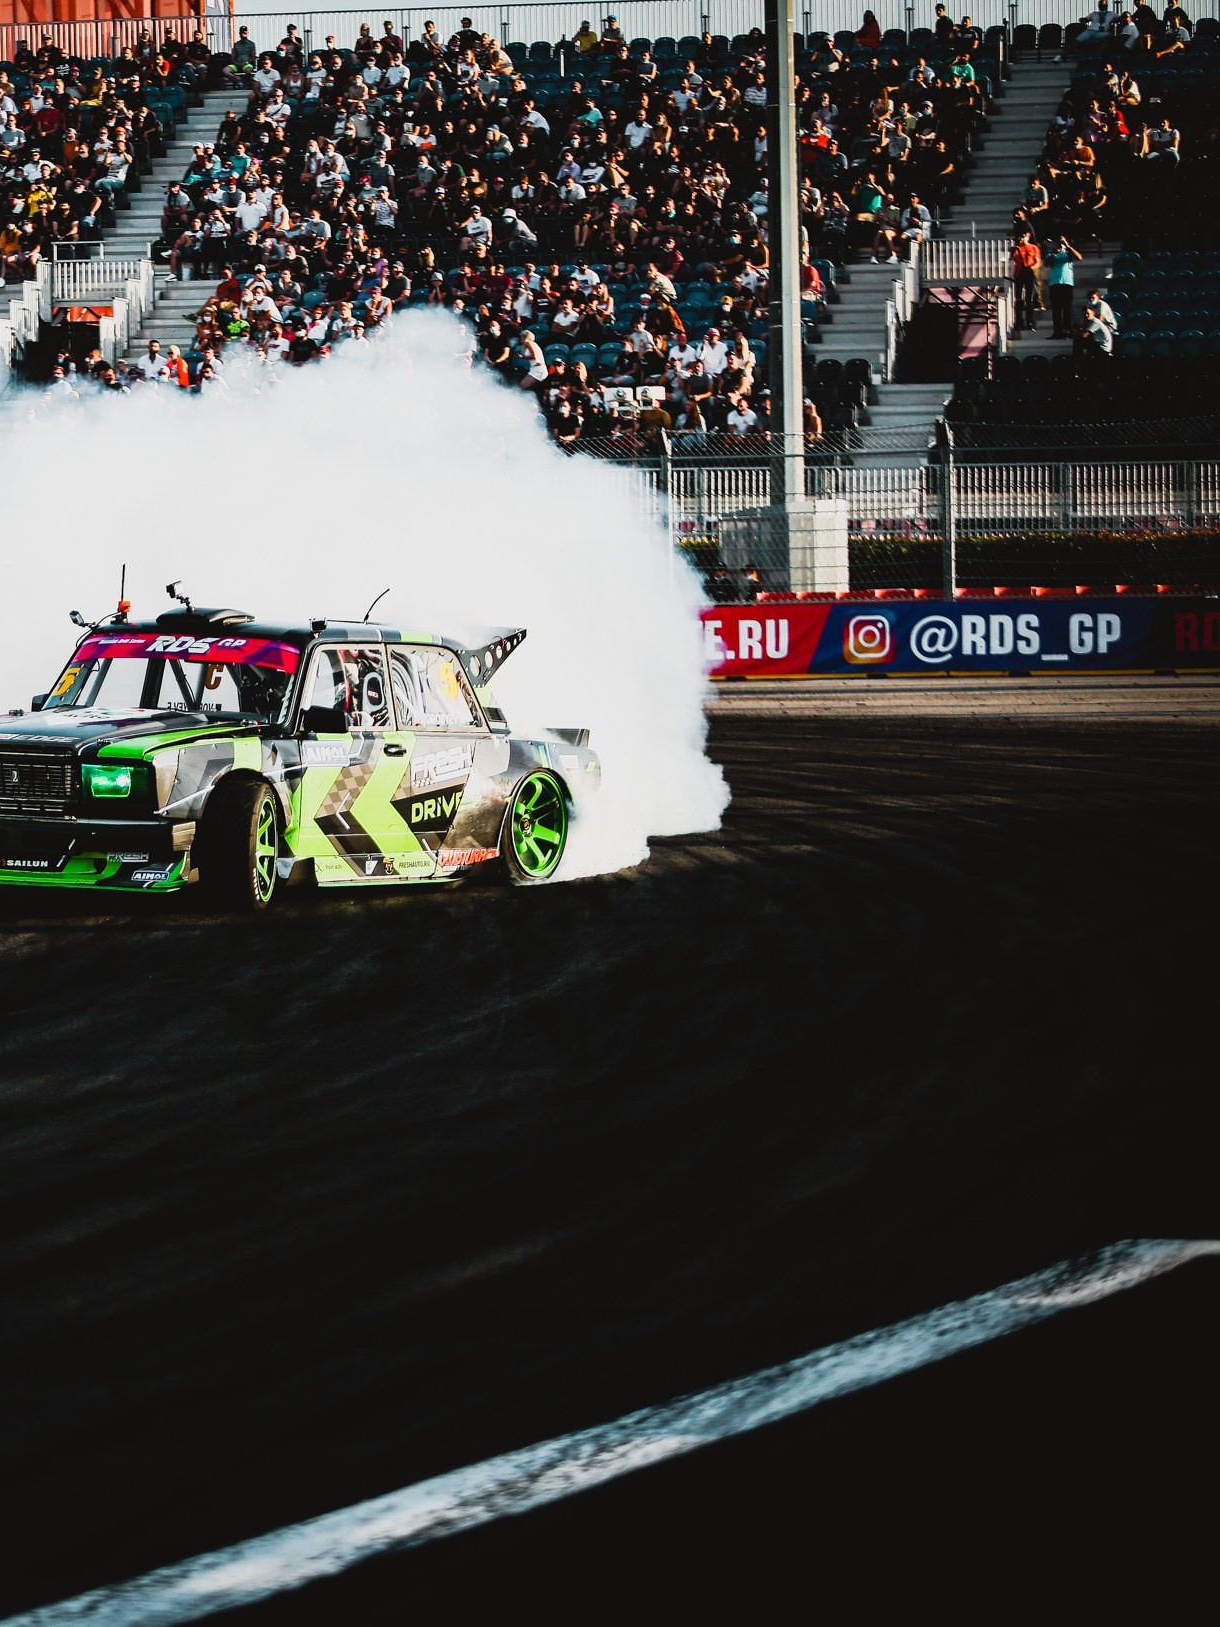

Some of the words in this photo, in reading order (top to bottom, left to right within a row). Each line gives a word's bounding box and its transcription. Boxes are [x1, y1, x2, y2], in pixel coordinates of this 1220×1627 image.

[146, 635, 220, 655] RDS
[698, 618, 788, 660] E.RU
[910, 613, 1121, 664] @RDS_GP
[52, 667, 81, 697] 5
[440, 662, 459, 699] 5
[13, 734, 80, 743] EDGE
[411, 744, 472, 787] FRESH
[107, 852, 149, 862] FRESH
[398, 859, 431, 869] FRESHAUTO.RU
[133, 872, 168, 880] AIMOL
